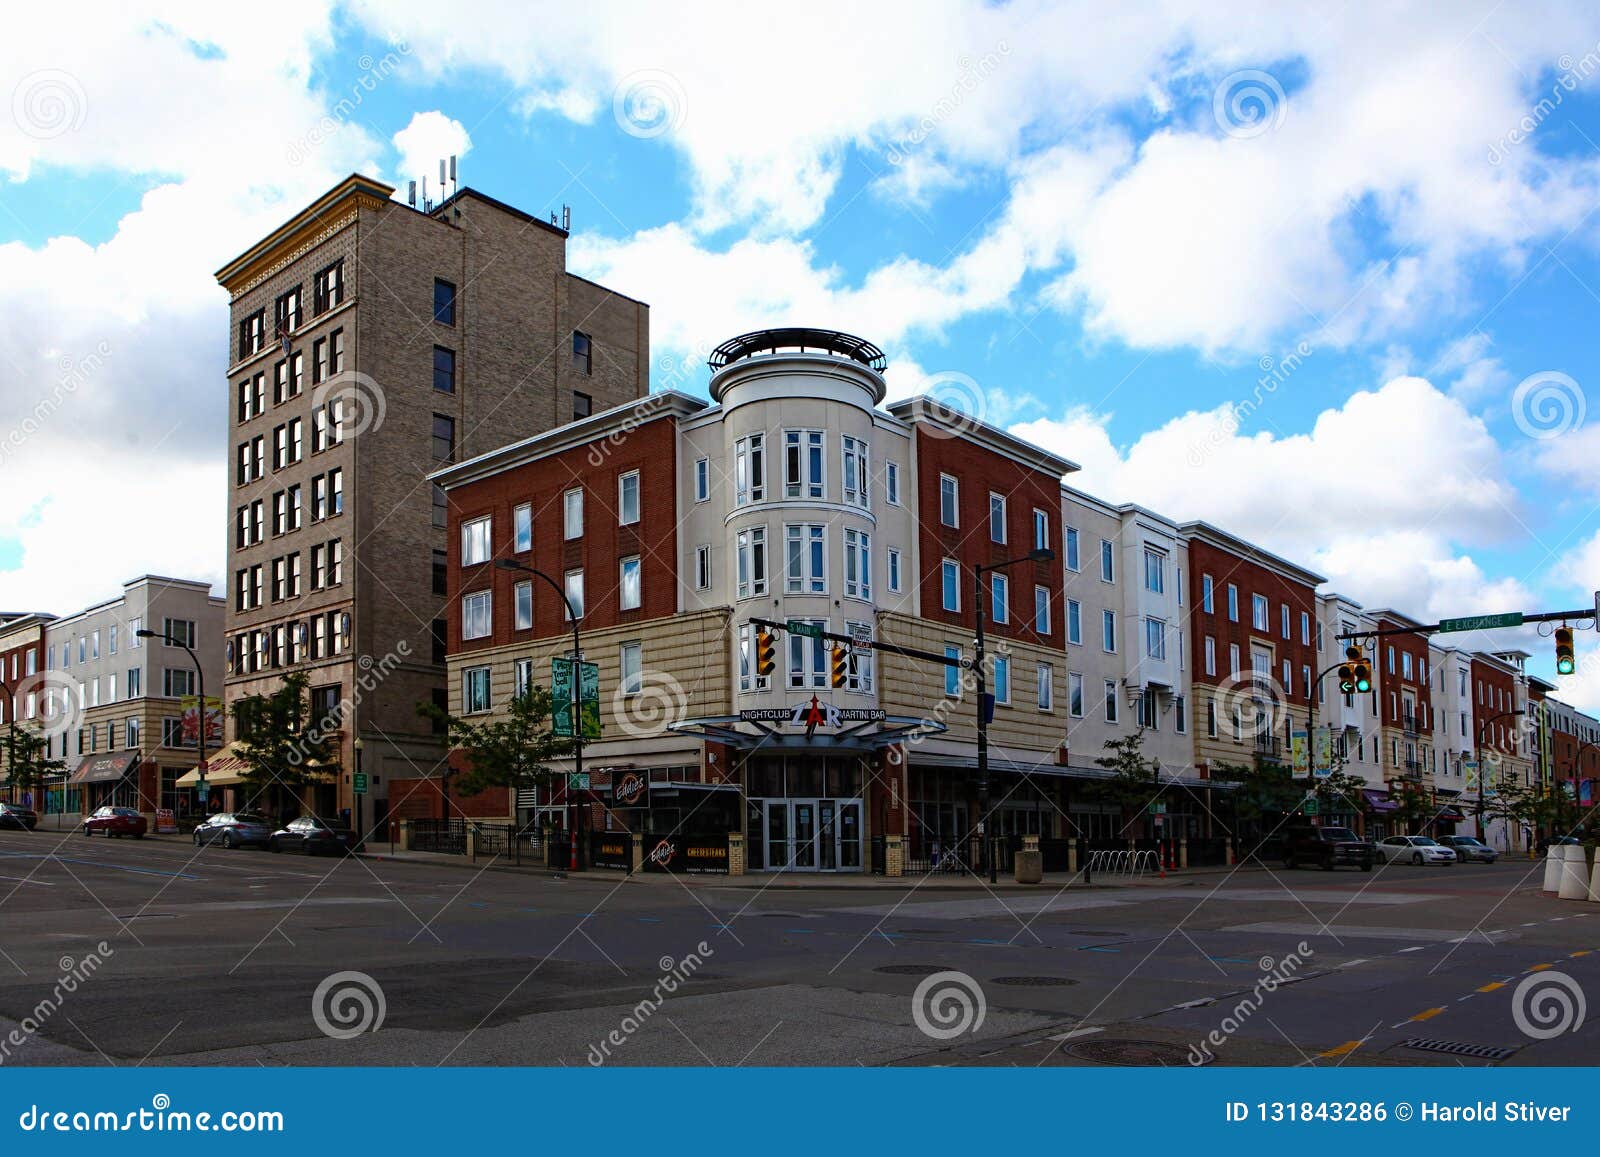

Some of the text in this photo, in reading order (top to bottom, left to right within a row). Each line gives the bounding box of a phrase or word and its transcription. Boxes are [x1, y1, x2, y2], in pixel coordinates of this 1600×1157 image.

[1446, 621, 1453, 631] E
[1456, 615, 1503, 629] EXCHANGE
[790, 625, 795, 633] S
[796, 625, 811, 635] MAIN
[556, 661, 572, 671] Play
[555, 677, 568, 686] ball
[741, 710, 791, 719] NIGHTCLUB
[790, 693, 842, 728] ZAR
[840, 710, 886, 720] MARTINI BAR
[687, 847, 727, 858] CHEESESTEAKS
